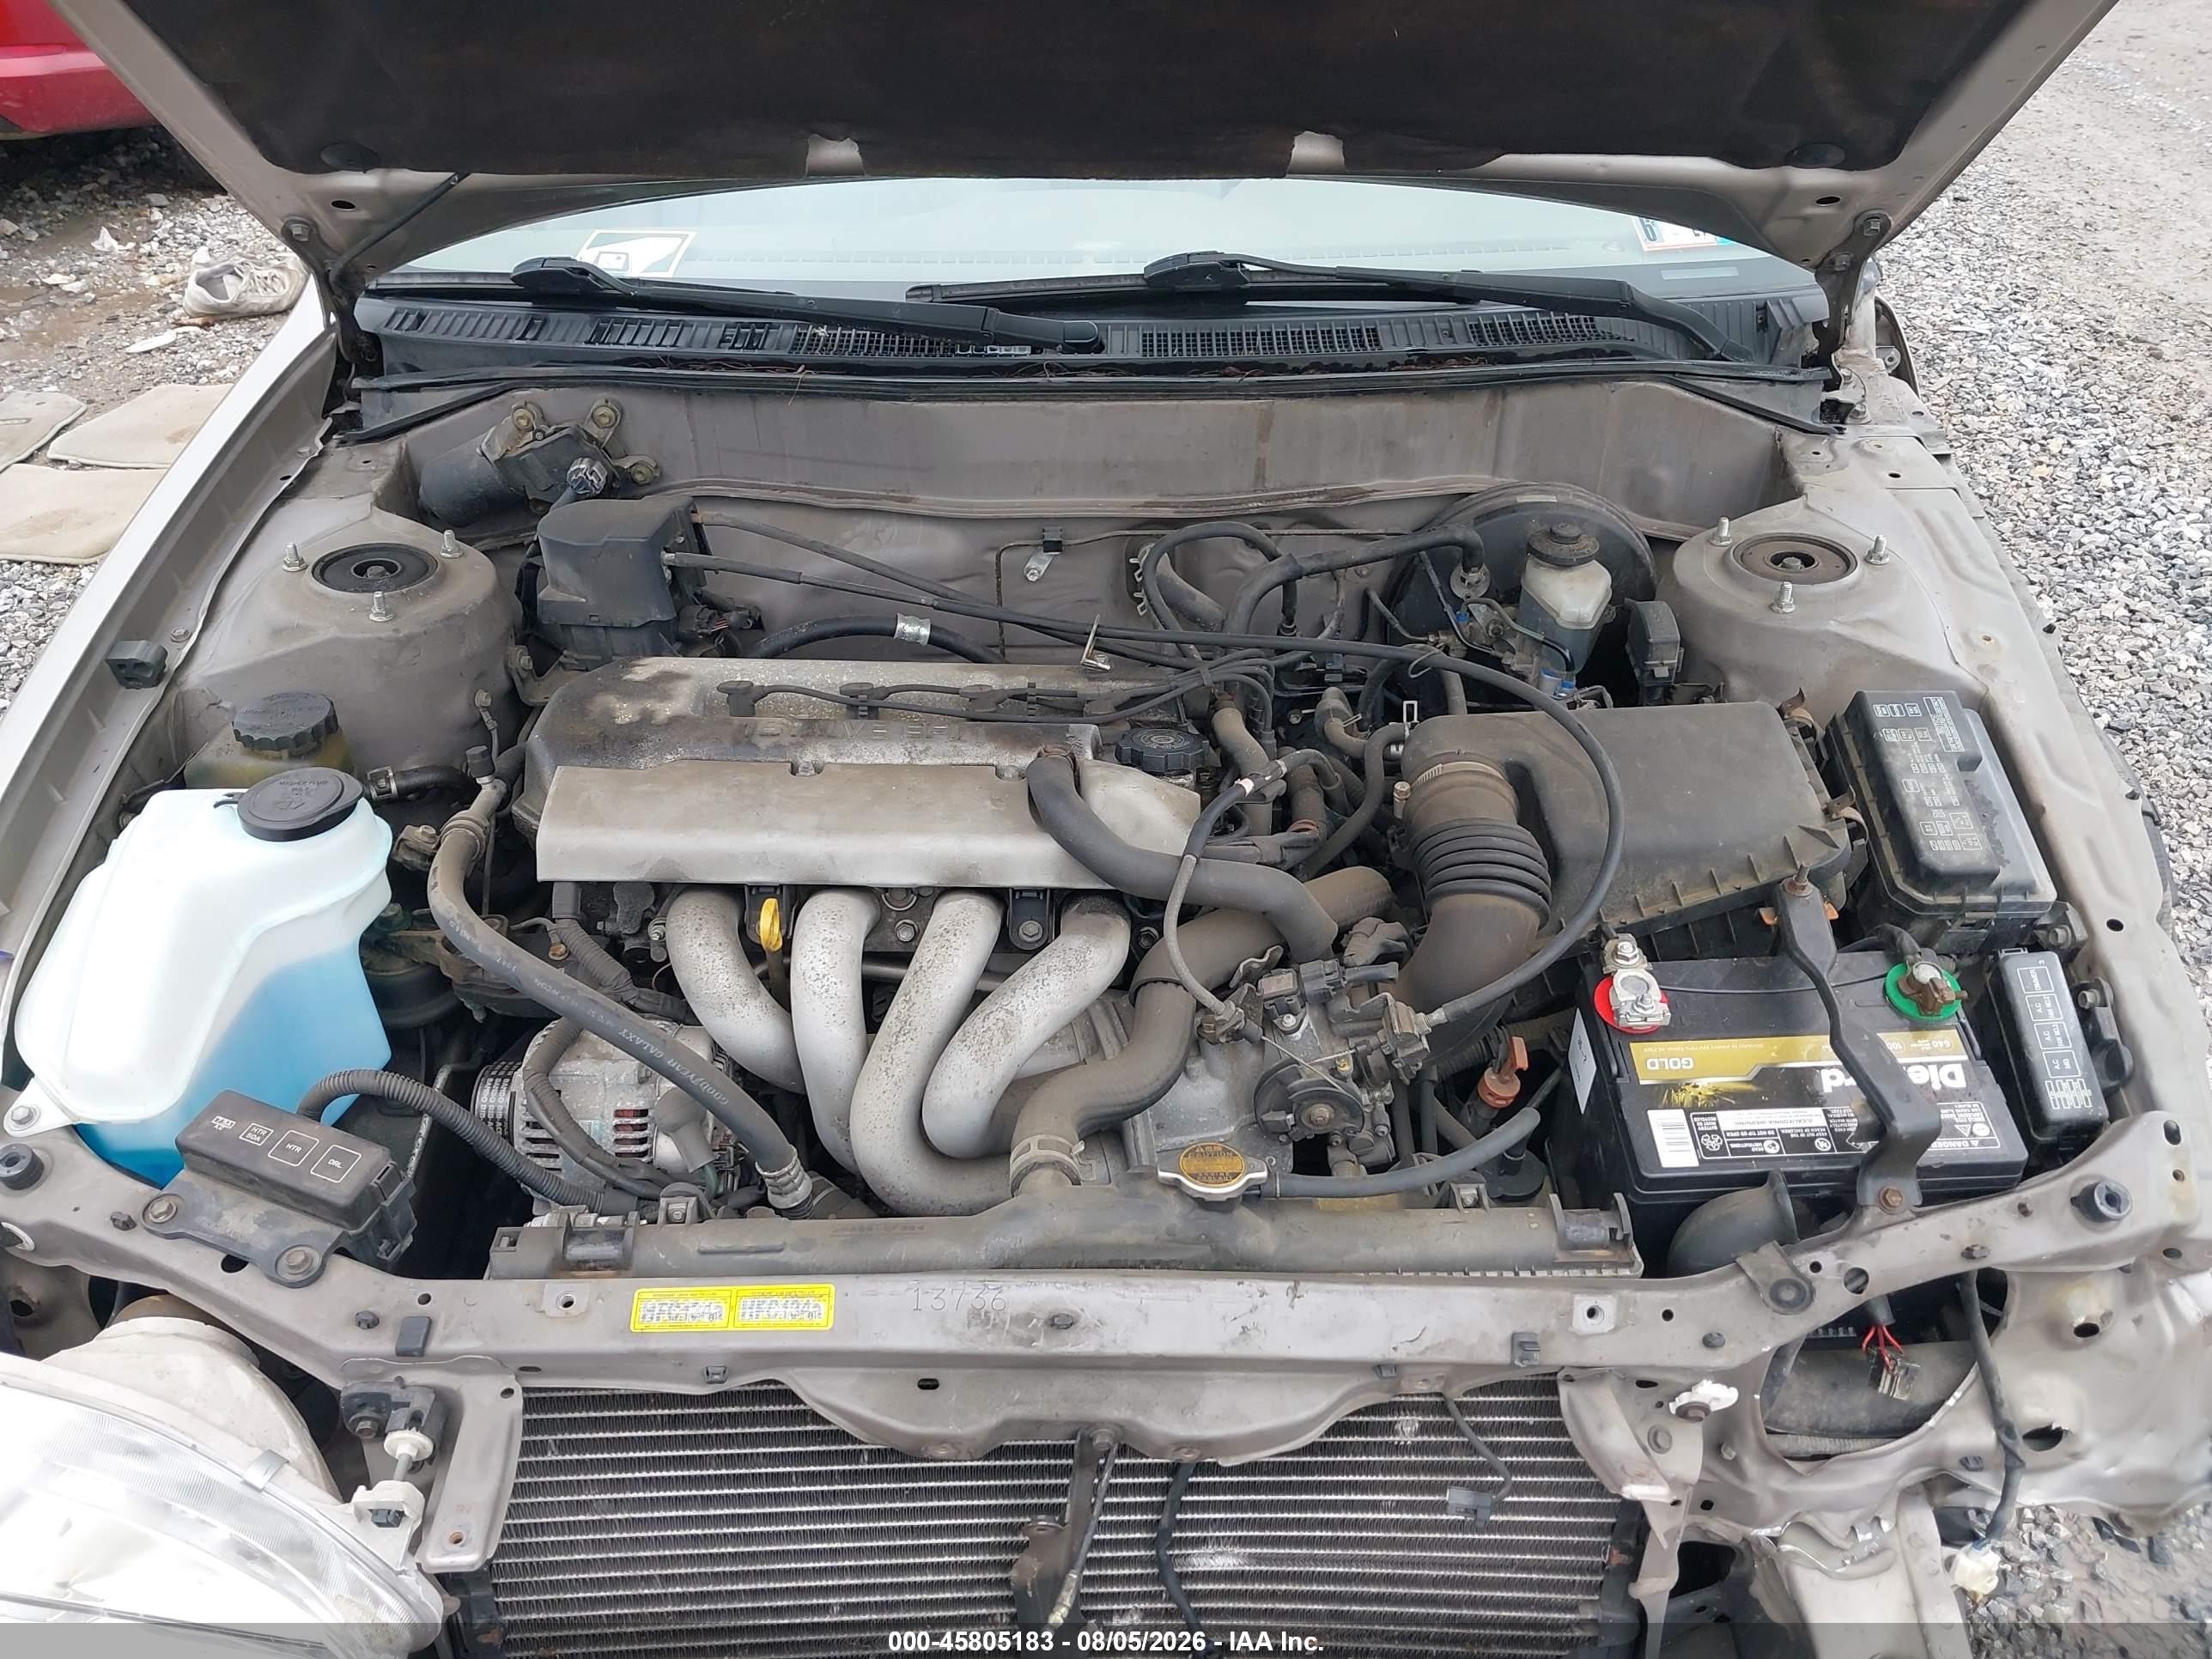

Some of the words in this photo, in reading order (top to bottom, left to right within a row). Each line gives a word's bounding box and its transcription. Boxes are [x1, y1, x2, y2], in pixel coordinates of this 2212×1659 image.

[2029, 969, 2041, 990] DIMMER
[617, 1029, 664, 1059] GALAXY
[1646, 1057, 1693, 1071] GOLD
[481, 1078, 494, 1103] BANDO
[489, 1078, 502, 1103] BANDO
[498, 1078, 510, 1103] BANDO
[252, 1126, 267, 1136] HTR
[286, 1144, 302, 1154] HTR
[328, 1158, 343, 1169] DRL
[913, 1287, 1006, 1312] 13736
